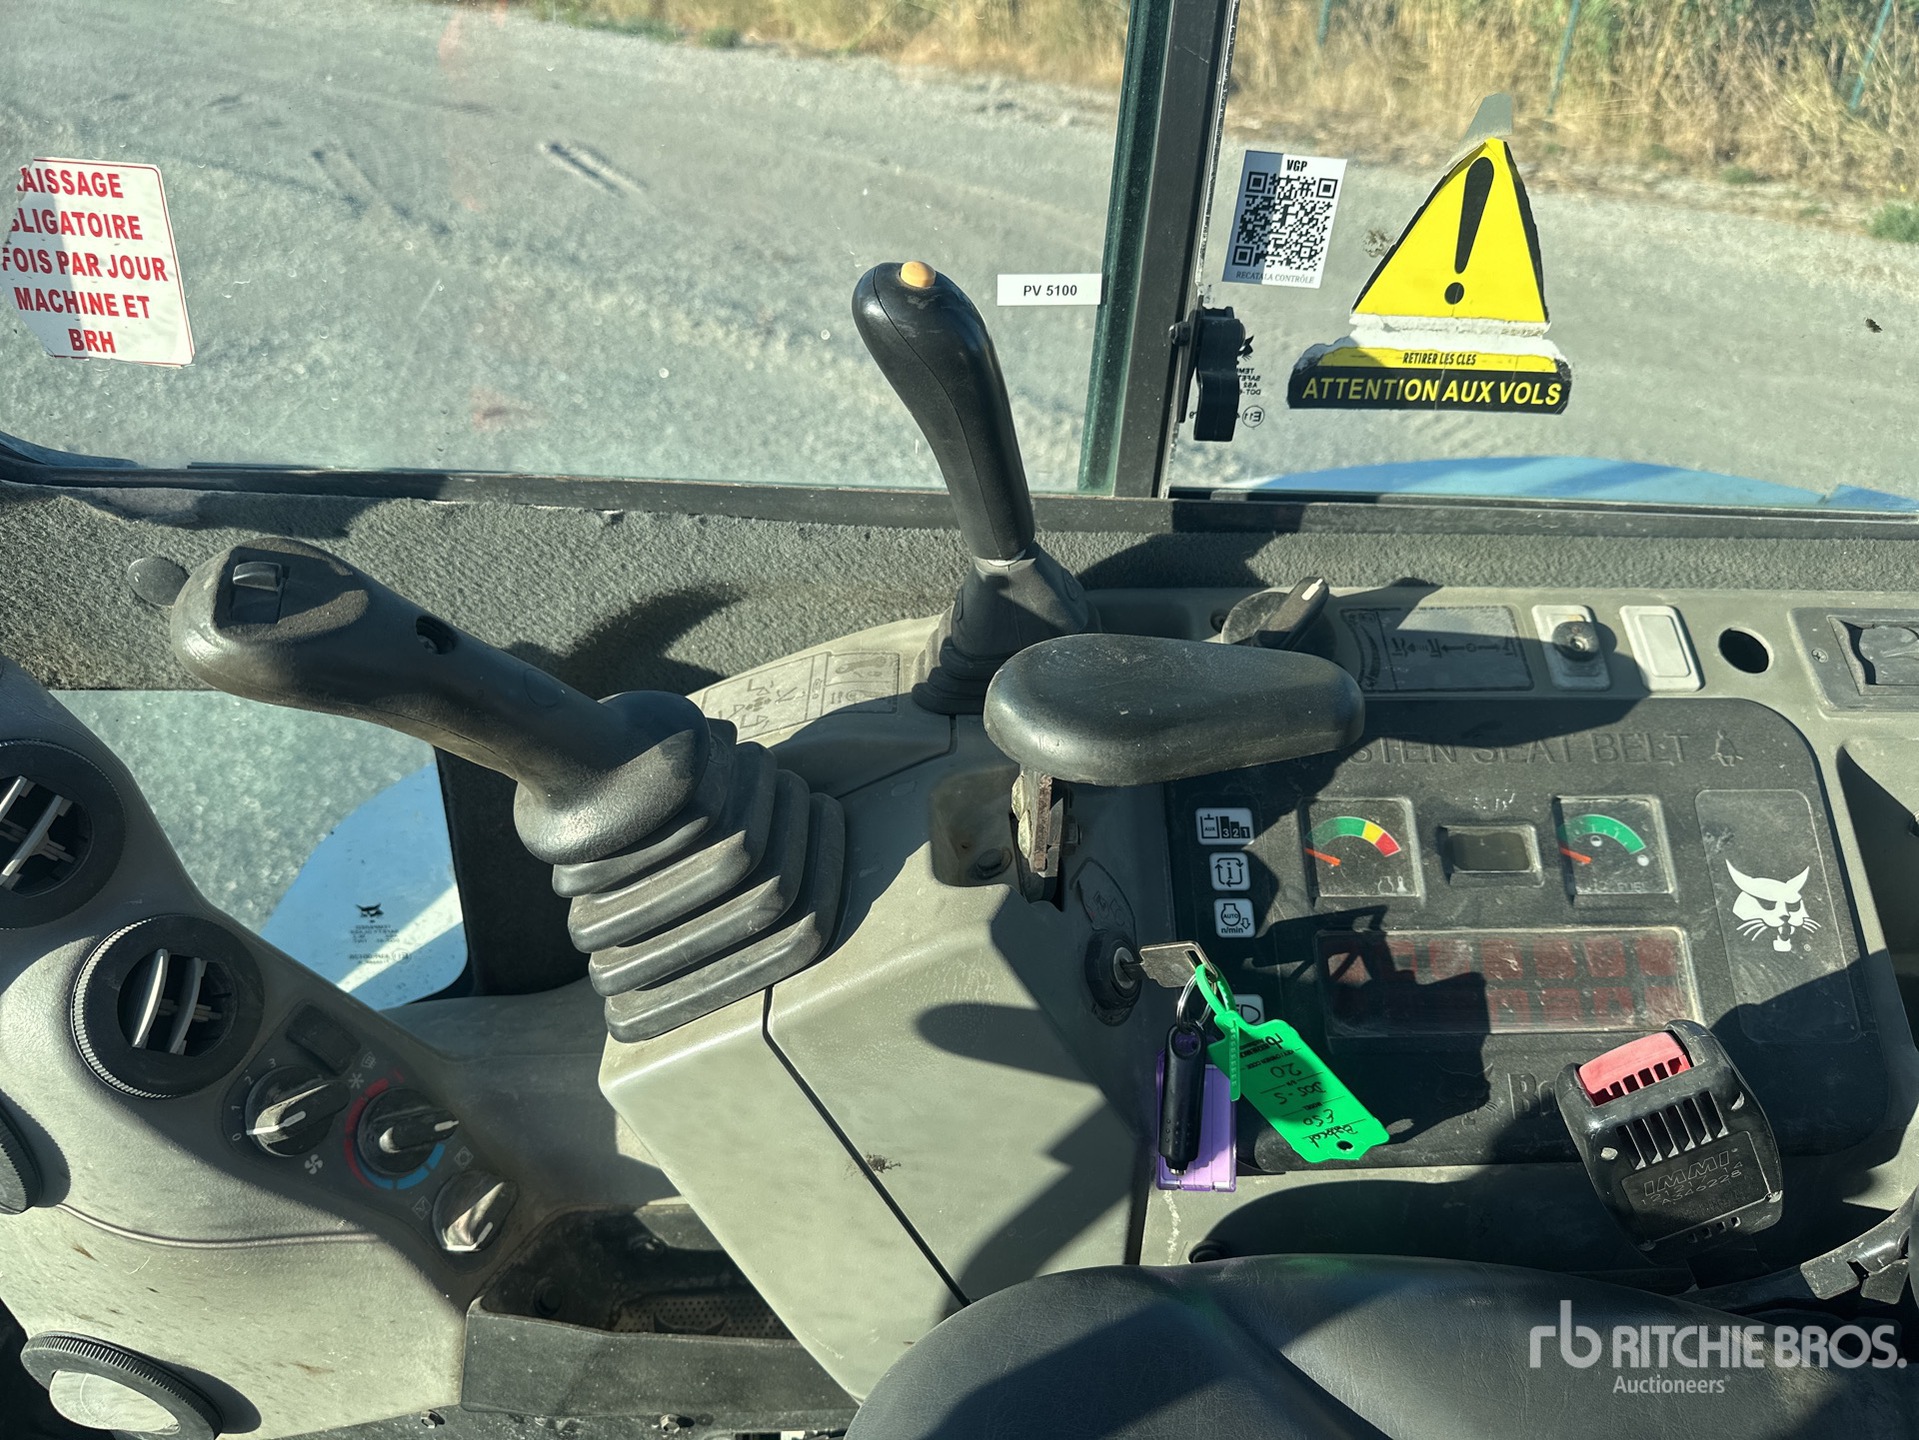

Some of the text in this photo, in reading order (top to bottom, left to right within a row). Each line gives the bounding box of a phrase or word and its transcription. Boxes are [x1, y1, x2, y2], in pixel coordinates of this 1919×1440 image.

[1286, 159, 1308, 172] VGP
[56, 250, 103, 278] PAR
[107, 254, 169, 282] JOUR
[1023, 285, 1078, 297] PV 5100
[14, 286, 150, 319] MACHINE ET
[68, 328, 117, 354] BRH
[1402, 352, 1477, 366] RETIRER LES CLES
[1302, 376, 1563, 406] ATTENTION AUX VOLS
[1590, 732, 1689, 765] BELT
[1222, 828, 1230, 838] 3
[1232, 828, 1240, 838] 2
[244, 1075, 255, 1085] 2
[1270, 1062, 1302, 1079] 20
[1643, 1150, 1730, 1197] IMMI
